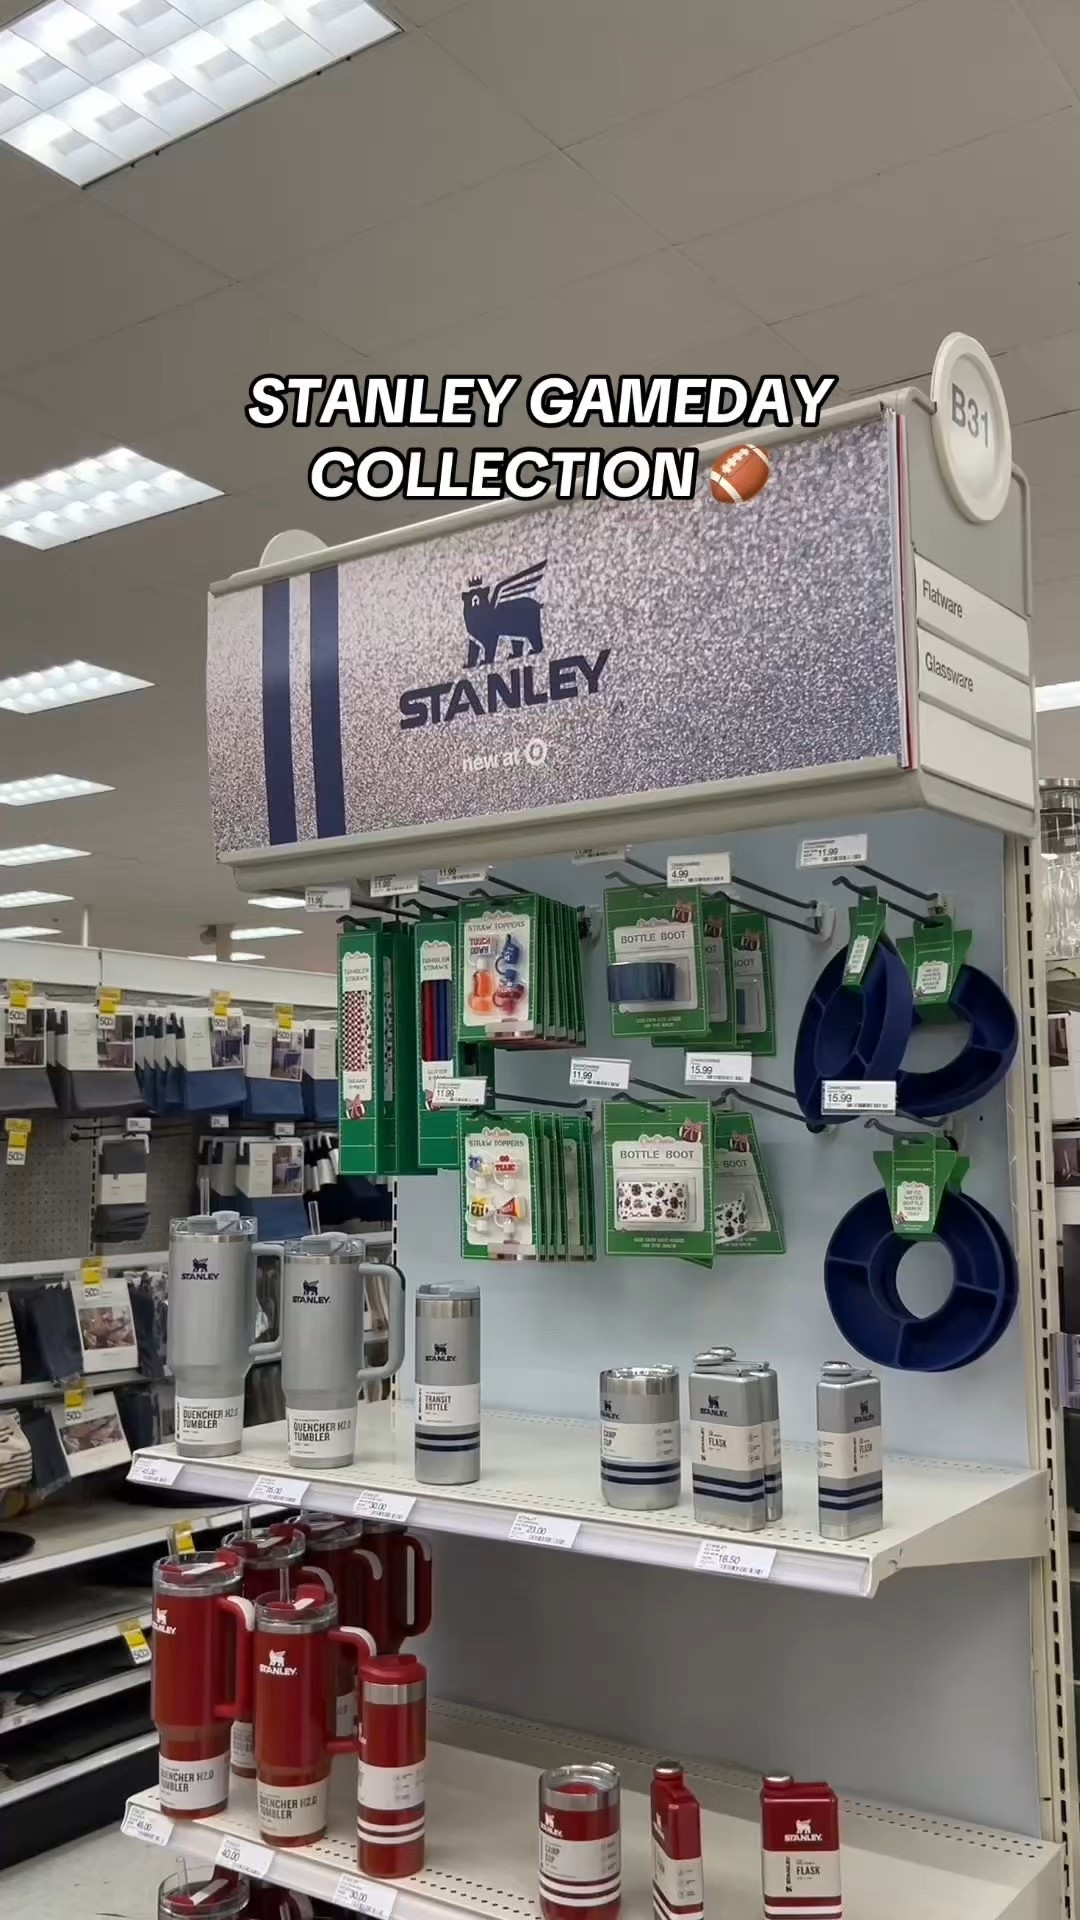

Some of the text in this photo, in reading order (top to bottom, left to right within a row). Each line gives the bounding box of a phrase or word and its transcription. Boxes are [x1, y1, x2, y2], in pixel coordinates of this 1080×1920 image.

[950, 382, 990, 449] B31
[922, 578, 964, 620] Flatware
[925, 651, 975, 693] Glassware
[400, 648, 612, 730] STANLEY
[462, 751, 496, 772] new
[818, 847, 838, 857] 11.99
[671, 869, 689, 879] 4.99
[468, 923, 492, 932] STRAW
[620, 930, 686, 944] BOTTLE BOOT
[572, 1070, 593, 1080] 11.99
[690, 1065, 713, 1075] 15.99
[436, 1089, 455, 1097] 11.99
[827, 1093, 852, 1103] 15.99
[469, 1138, 525, 1148] STRAW TOPPERS
[620, 1150, 695, 1159] BOTTLE BOOT
[722, 1160, 748, 1169] BOOT
[181, 1272, 220, 1281] STANLEY
[292, 1295, 330, 1304] STANLEY
[425, 1395, 451, 1404] TRANSIT
[425, 1402, 449, 1412] BOTTLE
[183, 1408, 223, 1419] QUENCHER
[700, 1407, 728, 1418] STANLEY
[183, 1419, 218, 1429] TUMBLER
[293, 1421, 336, 1432] QUENCHER
[293, 1431, 330, 1442] TUMBLER
[708, 1436, 727, 1449] FLASK
[526, 1525, 547, 1535] 23.00
[718, 1554, 740, 1565] 18.50
[259, 1663, 298, 1676] STANLEY
[784, 1833, 823, 1842] STANLEY
[796, 1865, 821, 1876] FLASK
